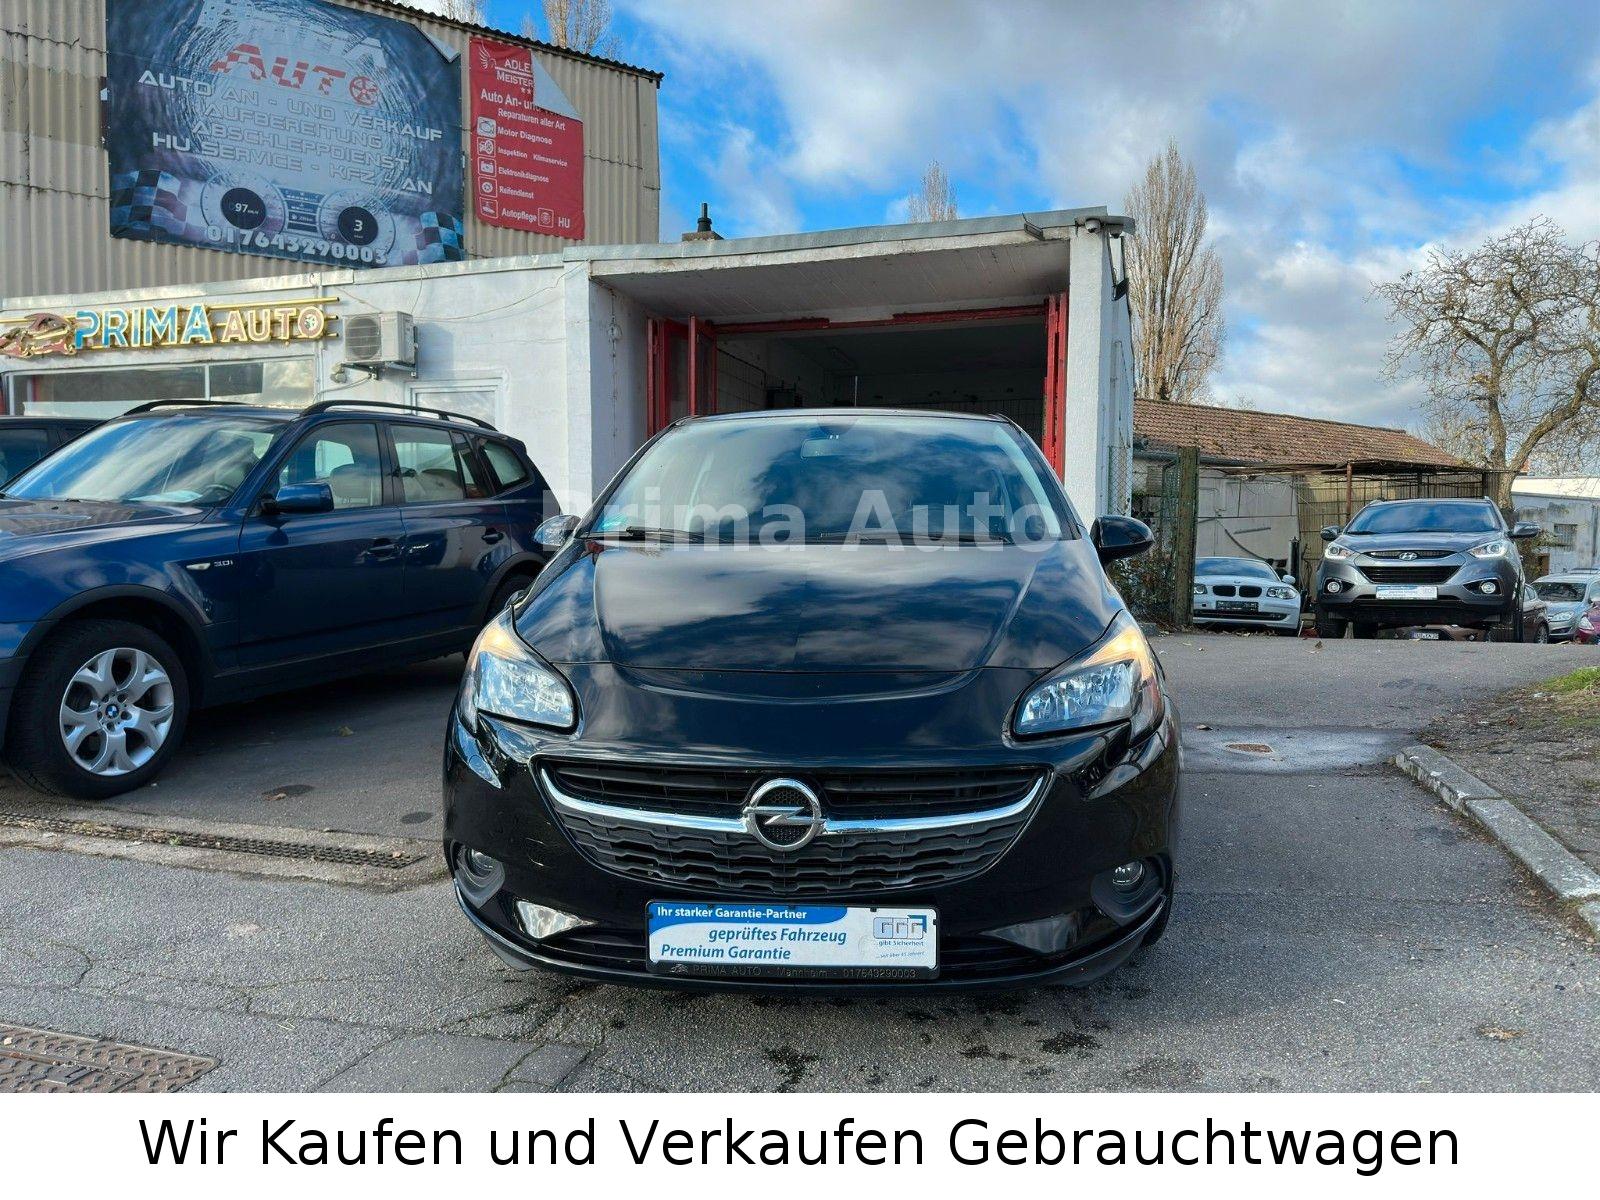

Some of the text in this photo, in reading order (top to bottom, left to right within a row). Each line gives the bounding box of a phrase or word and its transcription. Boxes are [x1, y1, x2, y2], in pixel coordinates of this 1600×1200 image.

[504, 58, 531, 73] ADLE
[137, 70, 213, 97] AUTO
[221, 88, 259, 106] AN
[288, 98, 335, 121] UND
[345, 110, 443, 141] VERKAUF
[480, 88, 503, 105] Auto
[505, 94, 522, 107] An-
[204, 103, 382, 149] AUFBEREITUNG
[497, 107, 538, 124] Reparaturen
[540, 116, 554, 128] aller
[555, 120, 566, 131] Art
[497, 126, 553, 145] Motor Diagnose
[191, 121, 410, 170] ABSCHLEPPDIENST
[497, 147, 528, 159] Inspektion
[152, 131, 190, 151] HU
[200, 141, 302, 172] SERVICE
[329, 163, 376, 185] KFZ
[402, 177, 433, 195] AN
[499, 185, 534, 199] Reifendienst
[235, 202, 248, 213] 97
[353, 219, 363, 232] 3
[501, 207, 570, 228] Autopflege HU
[207, 225, 388, 265] 017643290003
[75, 302, 325, 350] PRIMA AUTO
[657, 906, 807, 919] Ihr starker Garantie-Partner
[708, 926, 847, 946] geprüftes Fahrzeug
[661, 943, 792, 960] Premium Garantie
[693, 966, 726, 976] PRIMA
[731, 967, 762, 976] AUTO
